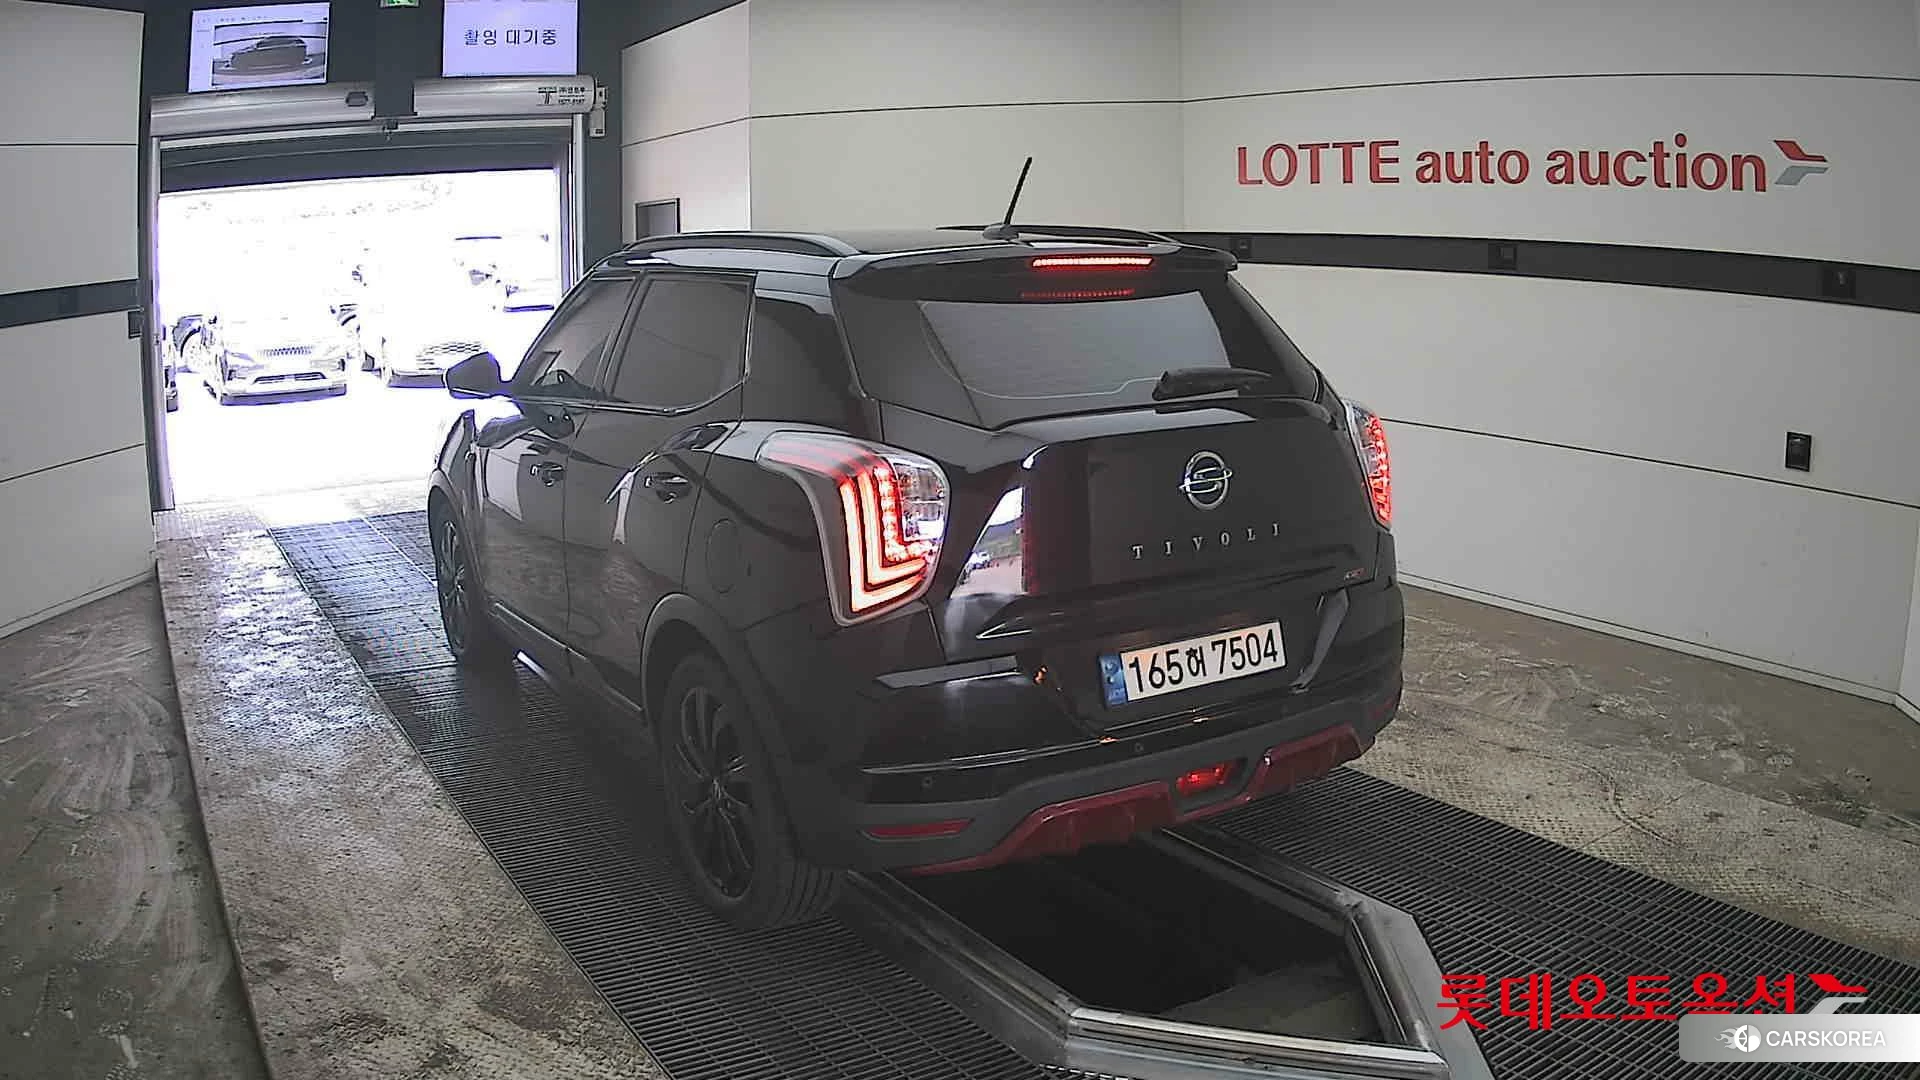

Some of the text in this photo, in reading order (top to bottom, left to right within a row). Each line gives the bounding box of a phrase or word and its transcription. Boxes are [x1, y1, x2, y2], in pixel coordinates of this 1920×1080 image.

[505, 29, 556, 45] 대기중
[1236, 133, 1768, 192] LOTTE auto auction
[1131, 523, 1280, 559] TIVOLI
[1129, 628, 1278, 693] 165허 7504
